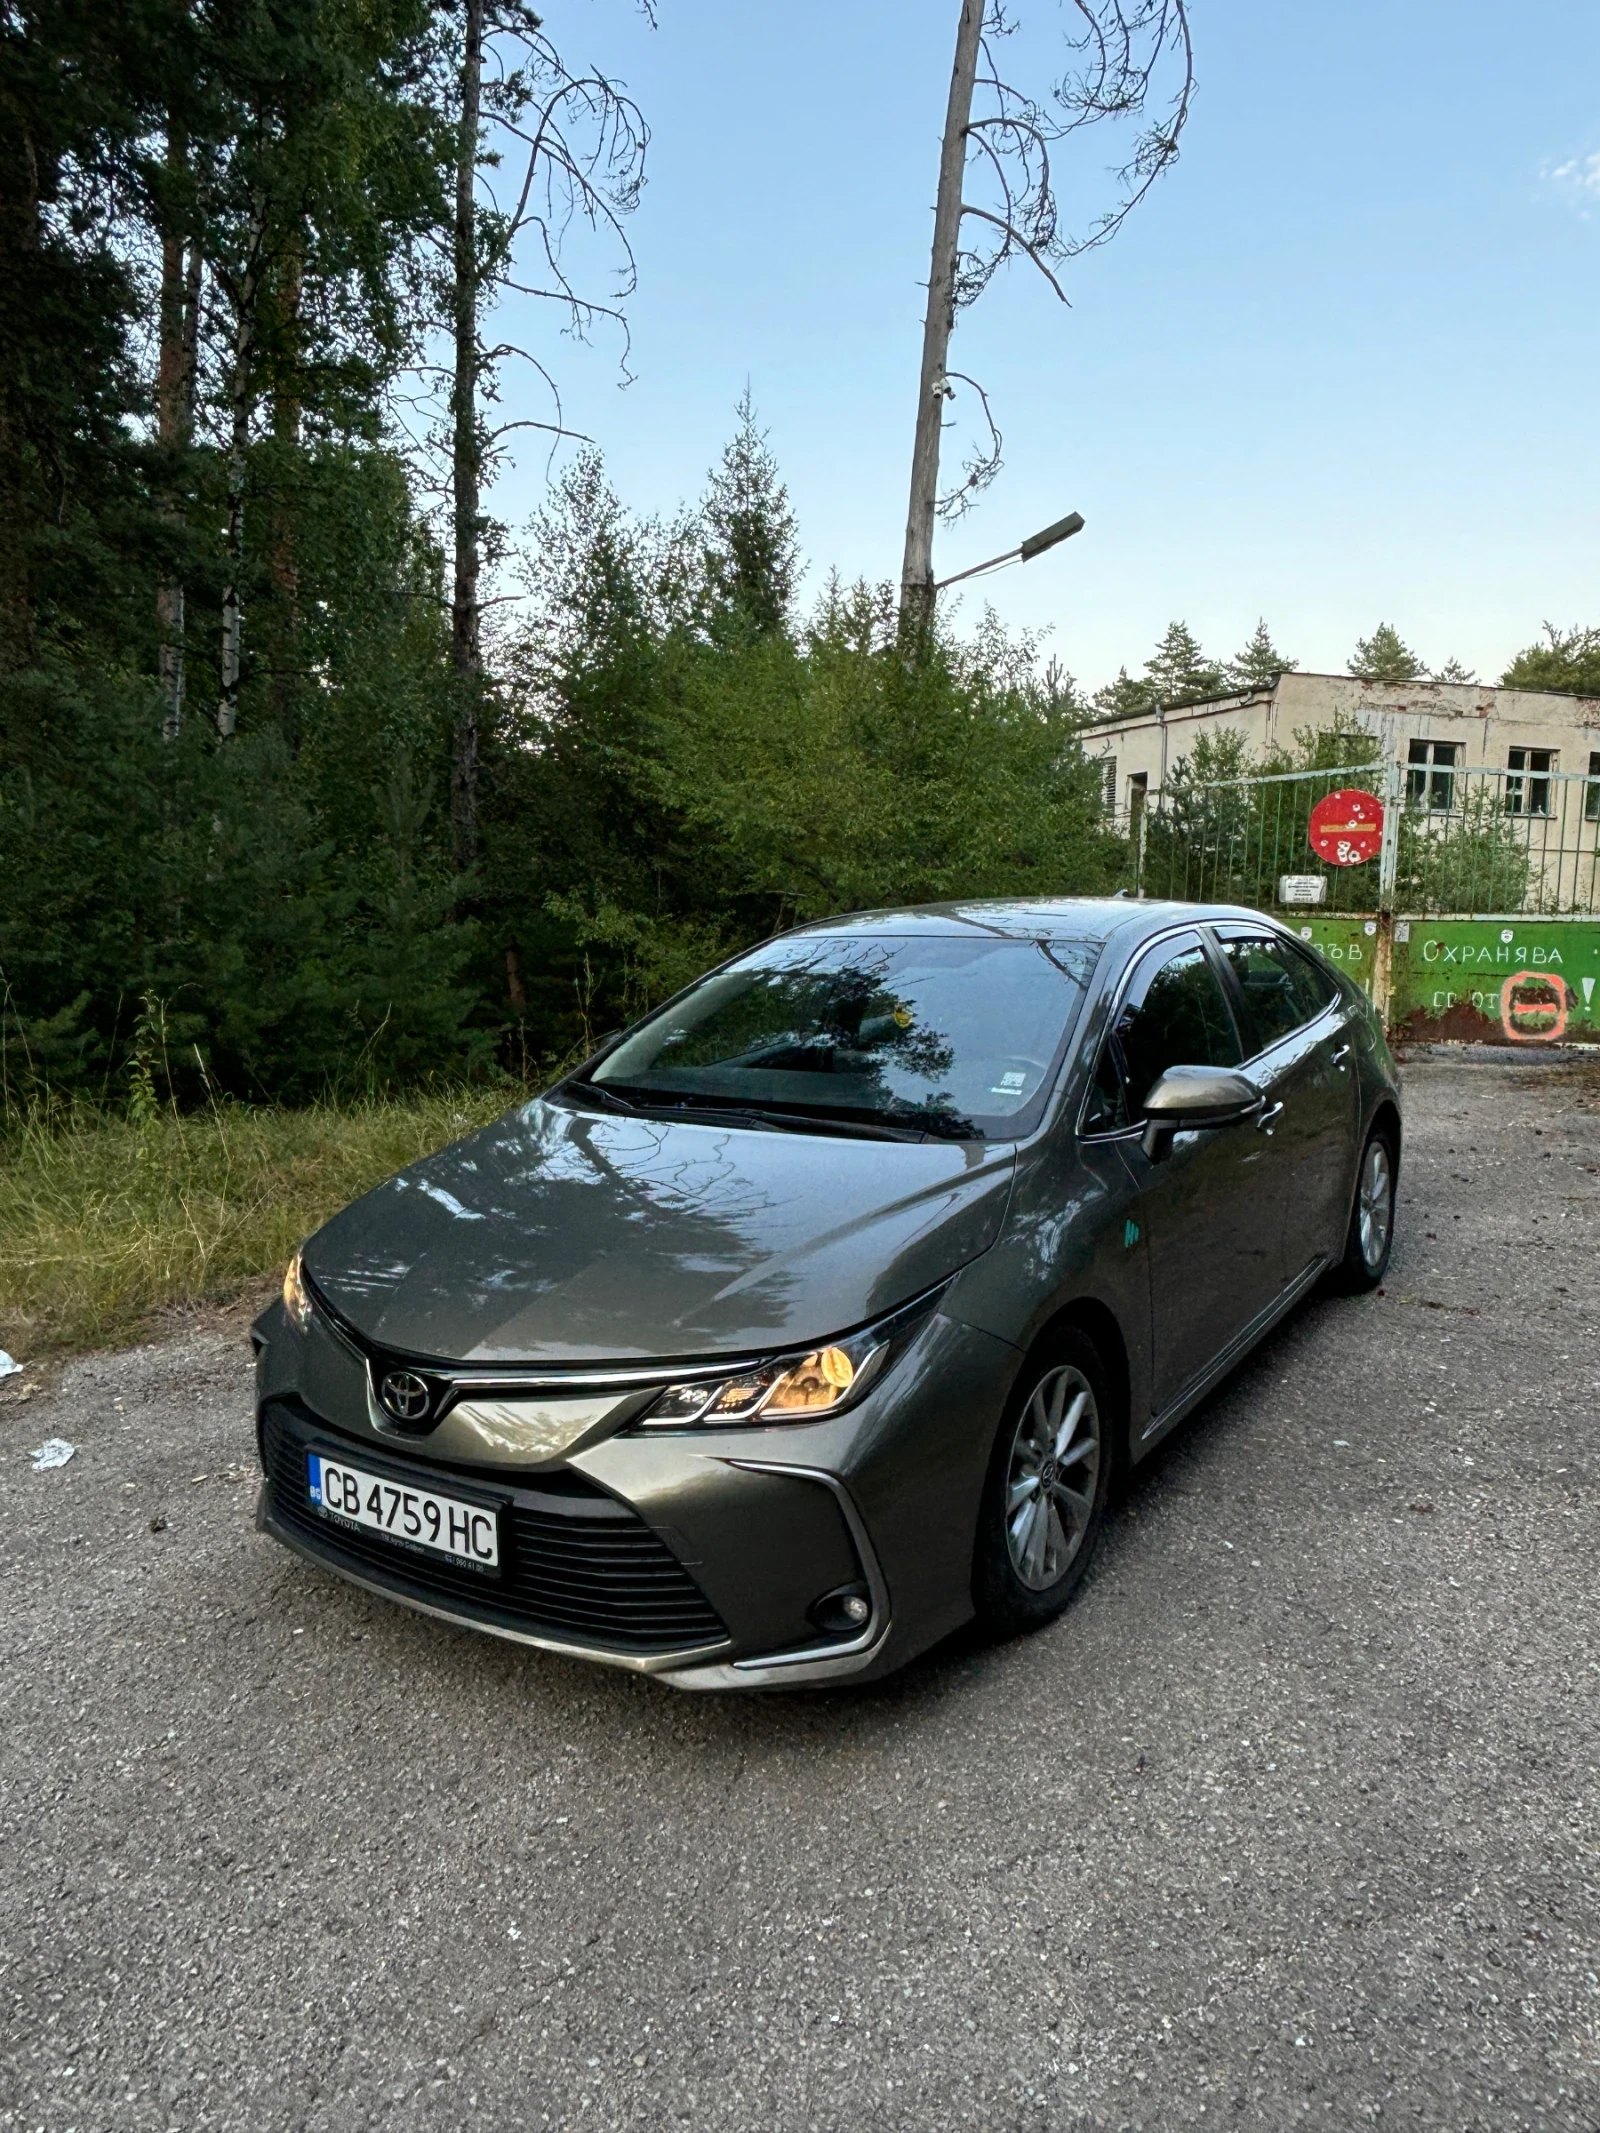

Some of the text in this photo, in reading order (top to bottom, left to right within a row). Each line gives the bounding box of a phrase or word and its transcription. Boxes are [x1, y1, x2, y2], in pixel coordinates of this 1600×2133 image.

[1423, 940, 1563, 964] ОХРАНЯВА
[1471, 991, 1499, 1009] ОТ
[309, 1486, 321, 1500] BG
